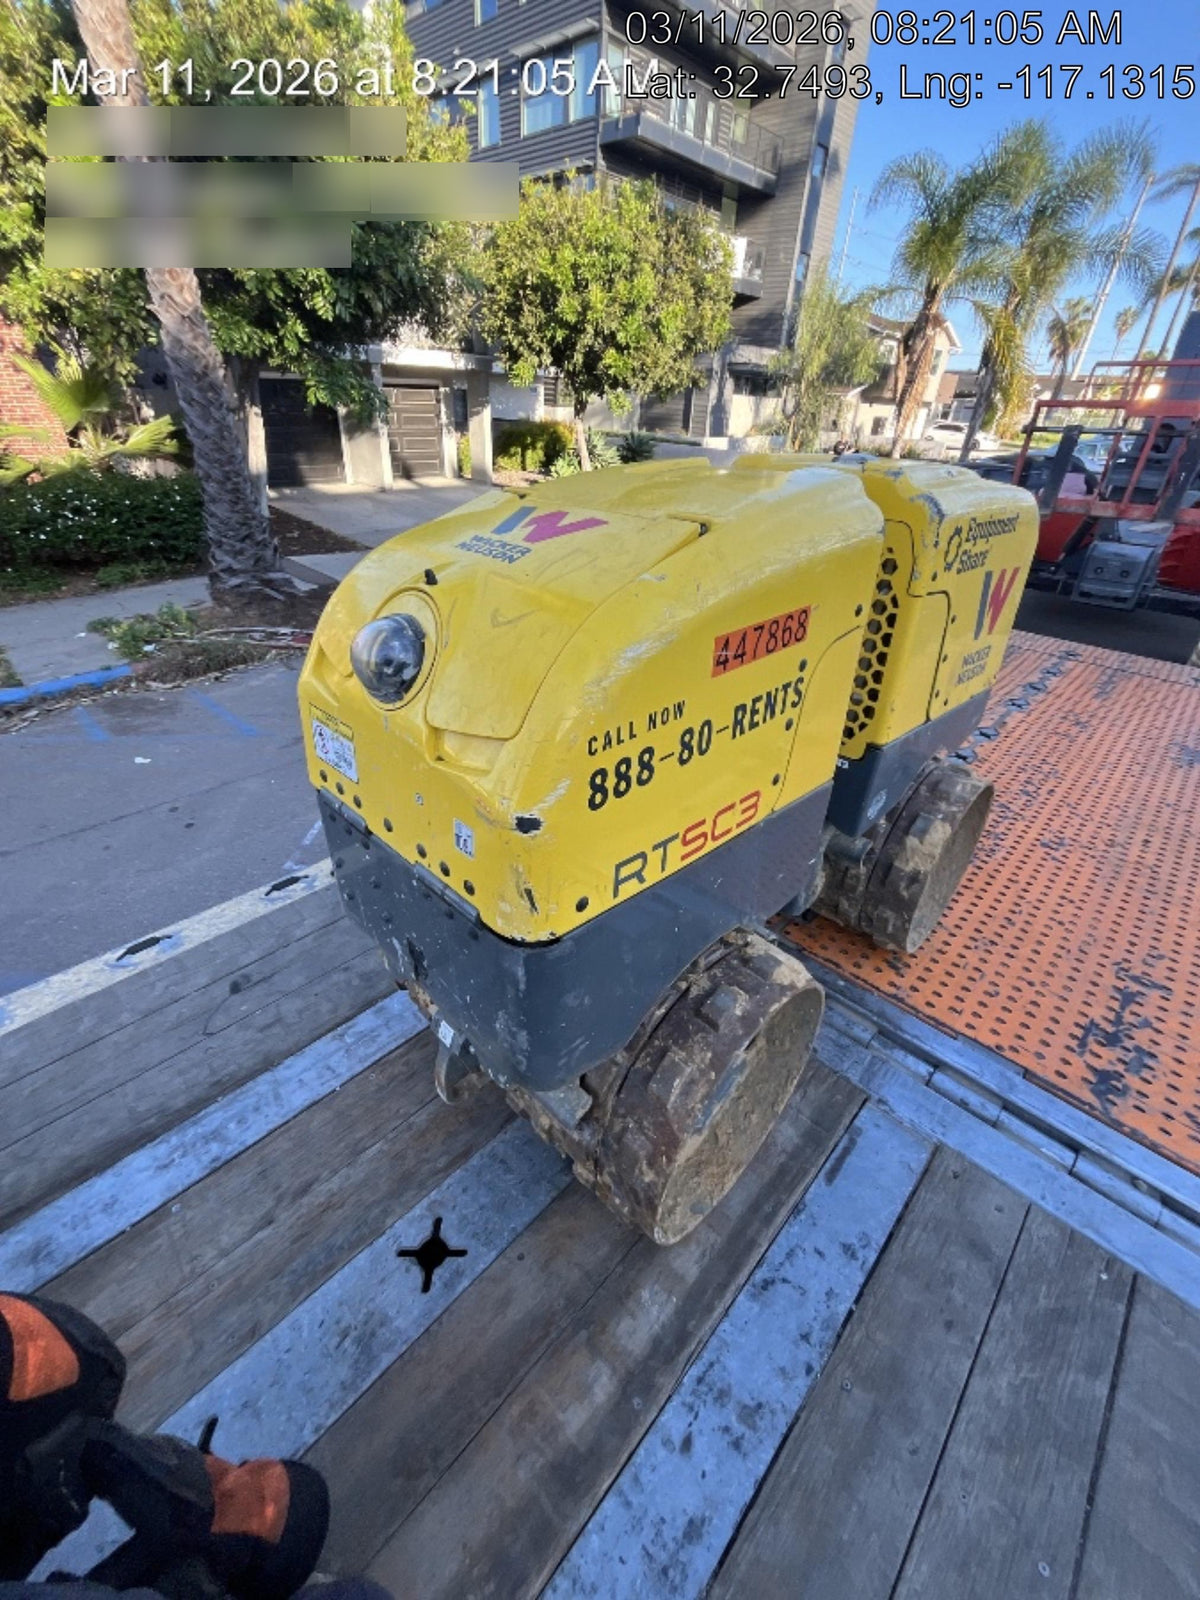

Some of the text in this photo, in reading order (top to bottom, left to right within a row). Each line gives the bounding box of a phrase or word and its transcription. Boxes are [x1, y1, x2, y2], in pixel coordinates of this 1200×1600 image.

[455, 541, 519, 564] NEUSON
[469, 534, 533, 558] WACKER
[714, 608, 810, 672] 447868
[587, 700, 686, 757] CALL NOW
[587, 676, 805, 812] 888-80-RENTS
[613, 790, 762, 900] RTSC3
